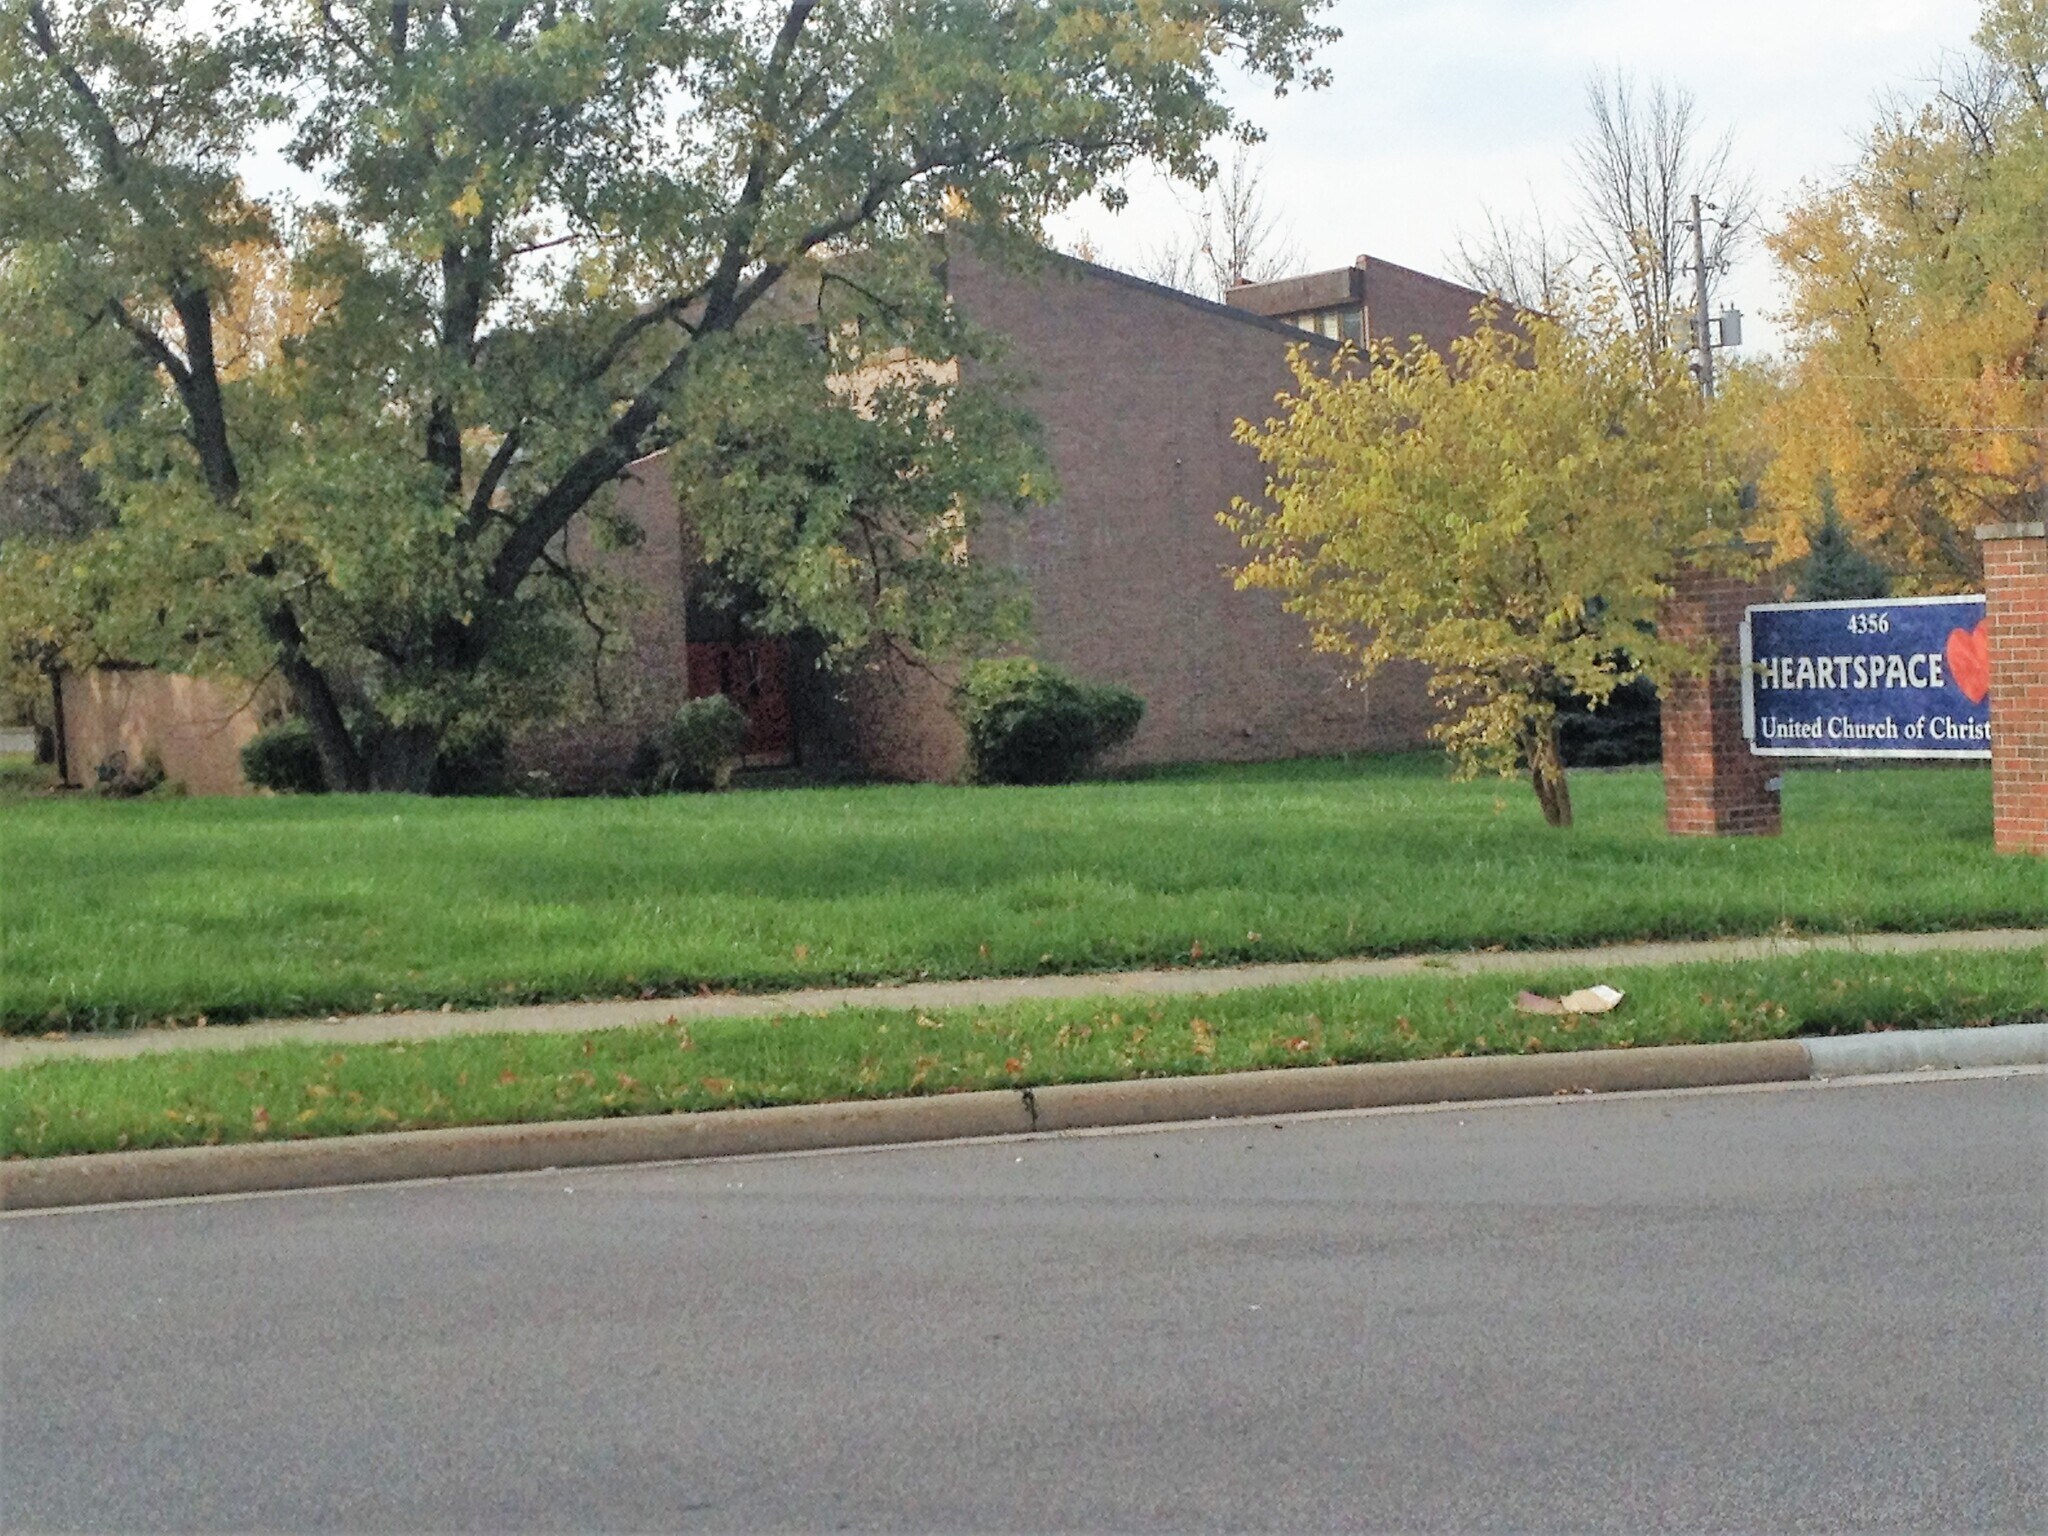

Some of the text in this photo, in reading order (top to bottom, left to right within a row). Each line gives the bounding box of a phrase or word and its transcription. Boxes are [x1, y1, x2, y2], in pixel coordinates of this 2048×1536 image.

[1847, 612, 1889, 634] 4356
[1760, 653, 1944, 690] HEARTSPACE
[1762, 715, 1991, 739] United Church of Christ
